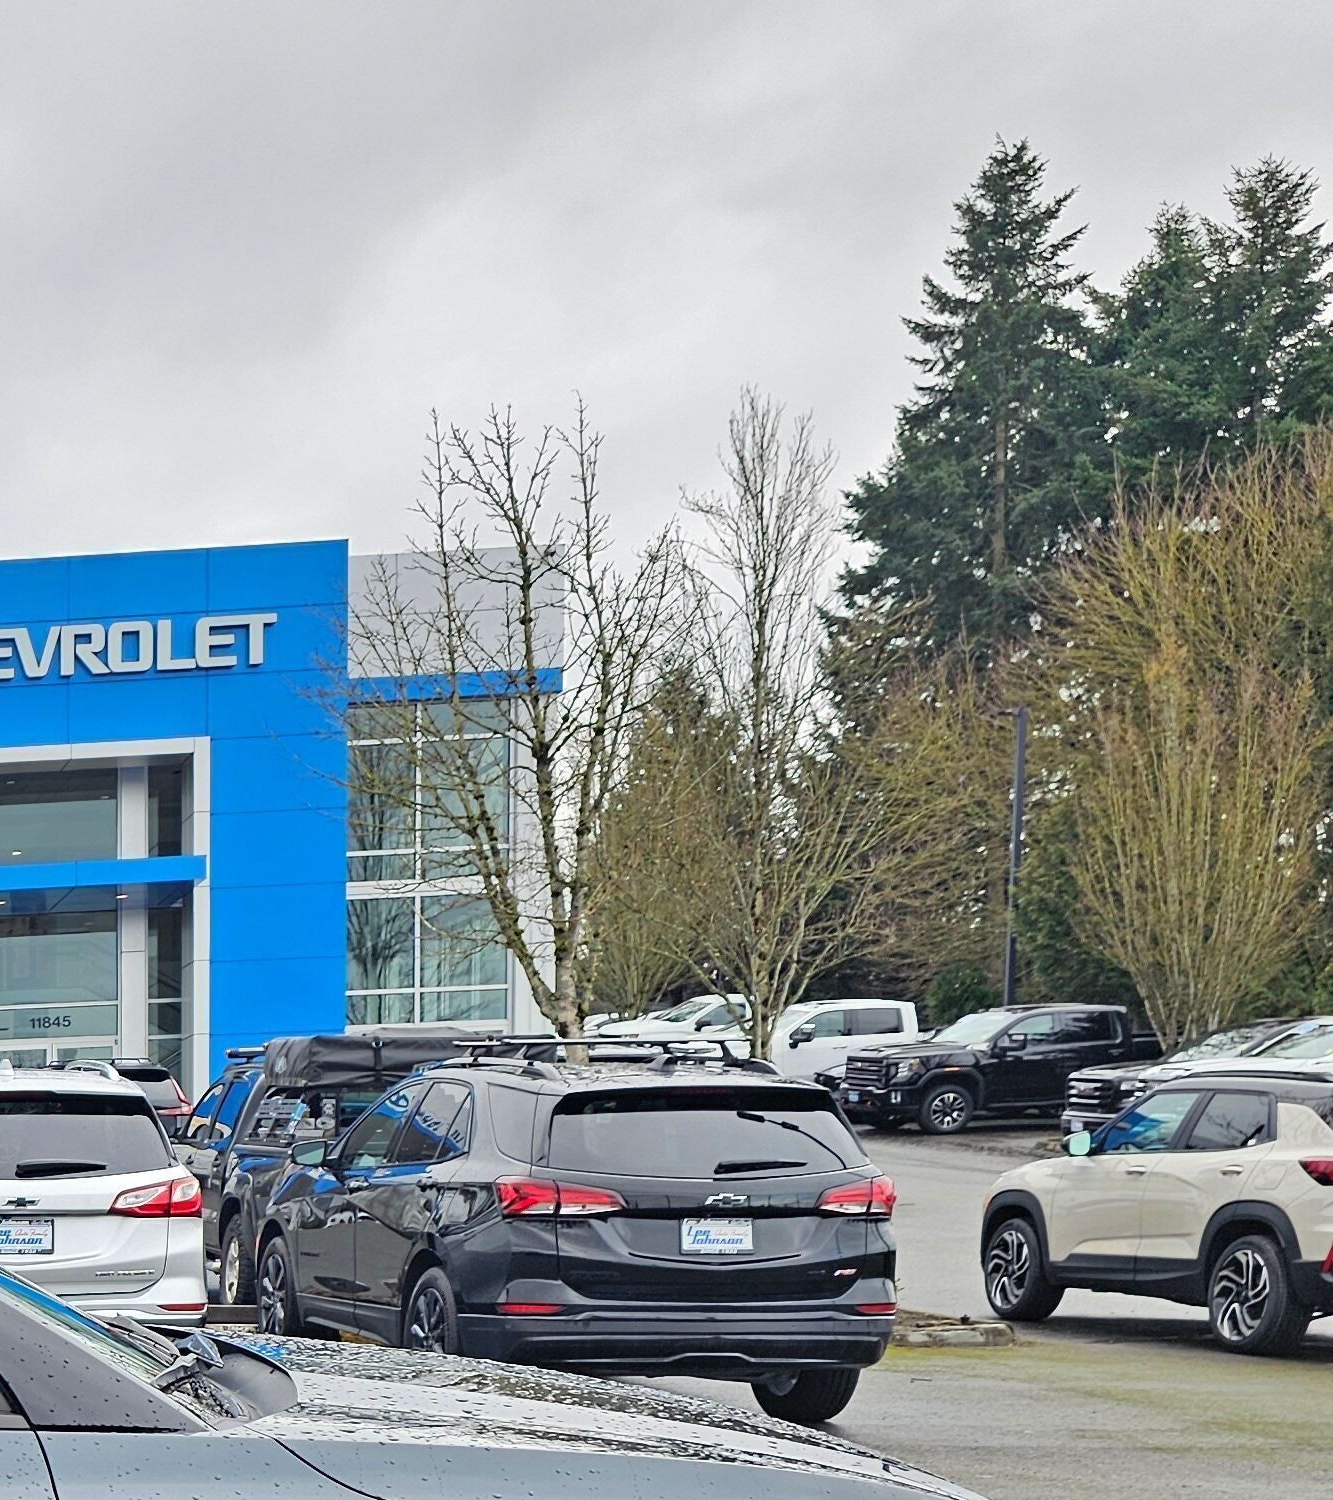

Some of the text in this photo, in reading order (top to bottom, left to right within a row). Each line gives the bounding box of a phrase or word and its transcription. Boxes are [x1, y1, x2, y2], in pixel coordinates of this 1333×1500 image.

[29, 1015, 71, 1029] 11845
[687, 1225, 712, 1237] Lee
[689, 1234, 744, 1246] Johnson
